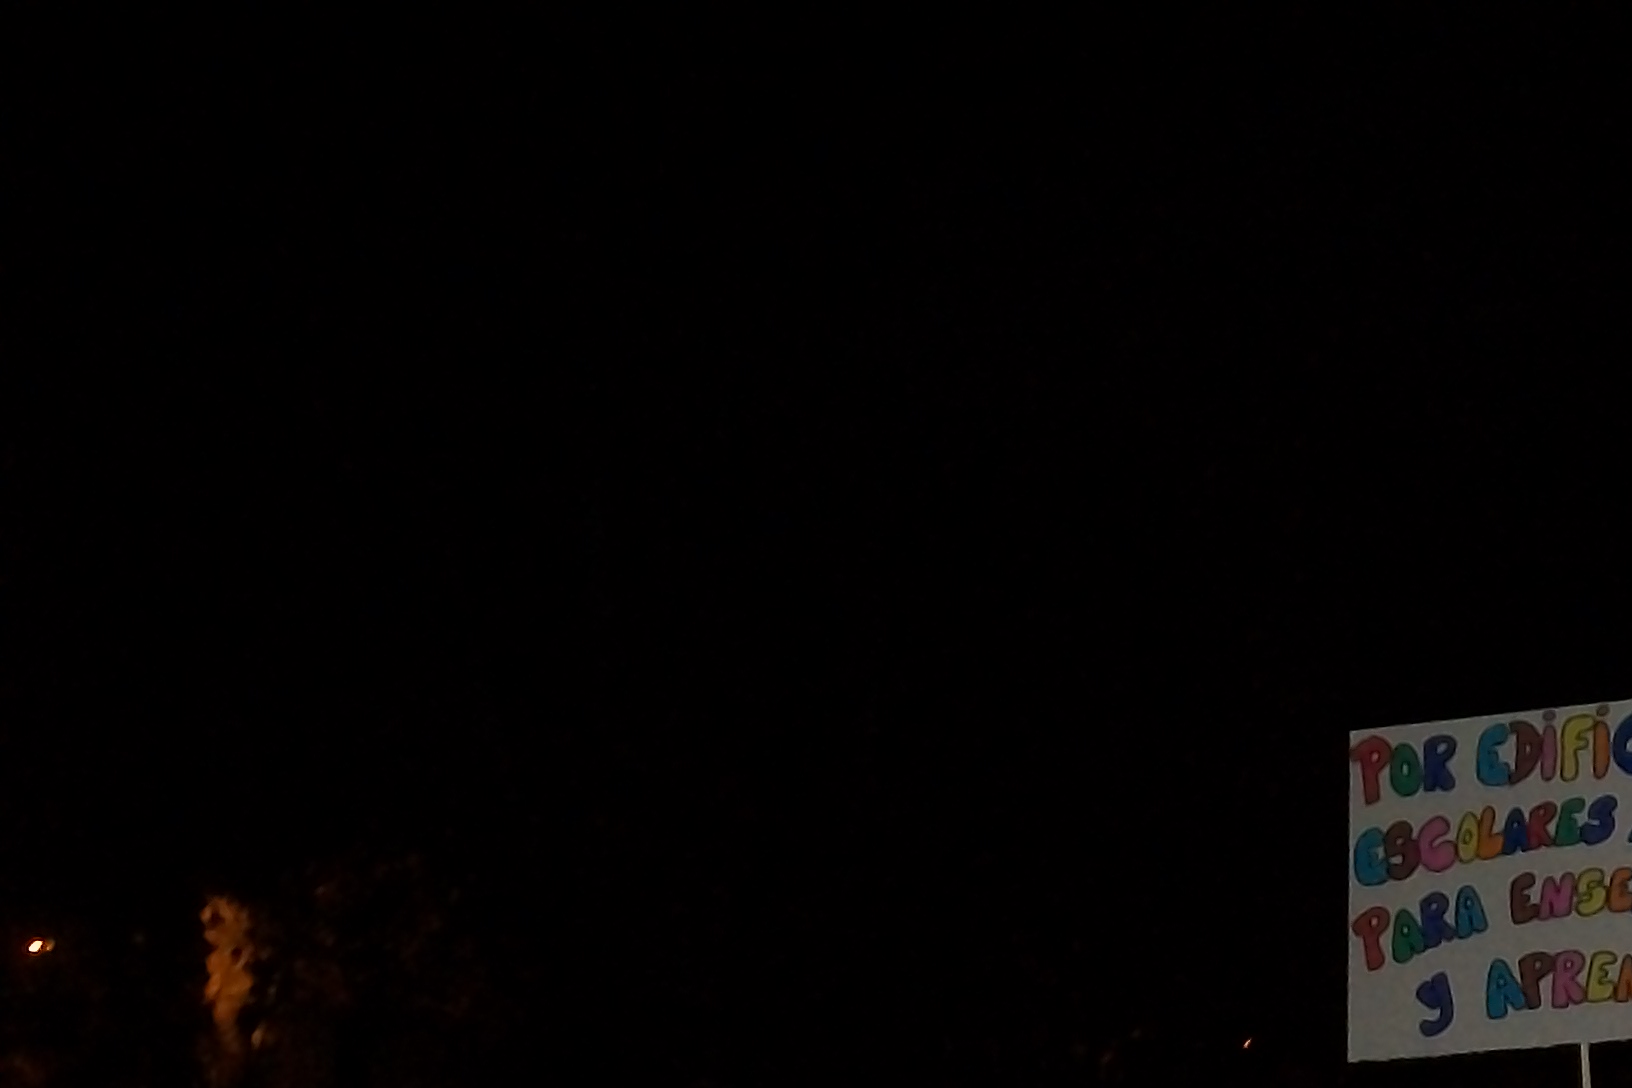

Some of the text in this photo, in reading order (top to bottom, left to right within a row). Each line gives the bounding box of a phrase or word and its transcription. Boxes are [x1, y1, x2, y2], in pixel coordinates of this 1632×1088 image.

[1350, 734, 1457, 805] POR
[1353, 794, 1618, 886] ESCOLARES
[1351, 884, 1489, 971] PARA
